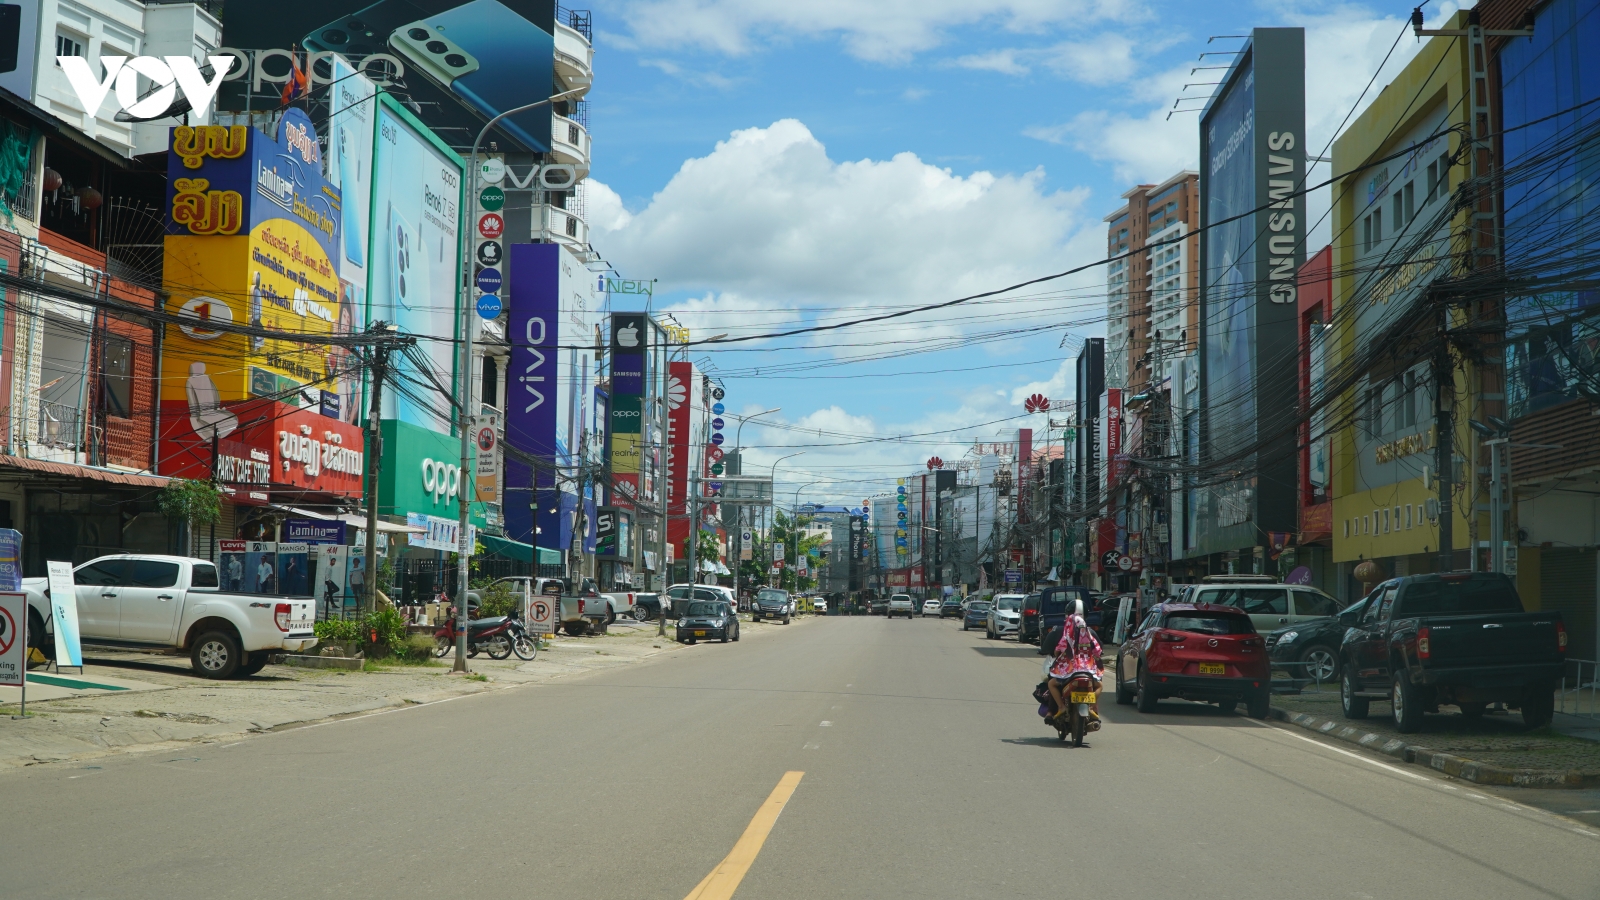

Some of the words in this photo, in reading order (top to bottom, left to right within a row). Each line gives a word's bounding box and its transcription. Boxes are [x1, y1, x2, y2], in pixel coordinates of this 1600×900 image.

[1211, 147, 1227, 177] Galaxy
[258, 160, 285, 199] Lamina
[441, 168, 457, 189] oppo
[424, 184, 442, 214] Reno6
[481, 194, 503, 202] oppo
[292, 191, 319, 228] Exclusive
[319, 210, 334, 243] shop
[1268, 131, 1296, 305] SAMSUNG
[478, 303, 500, 311] vivo
[519, 316, 546, 414] vivo
[612, 410, 640, 418] oppo
[611, 448, 639, 457] realme
[216, 453, 235, 482] PARIS
[236, 458, 251, 483] CAFE
[253, 462, 271, 488] STORE
[422, 457, 461, 506] opp
[289, 525, 326, 537] Lamina
[326, 546, 338, 554] H&M
